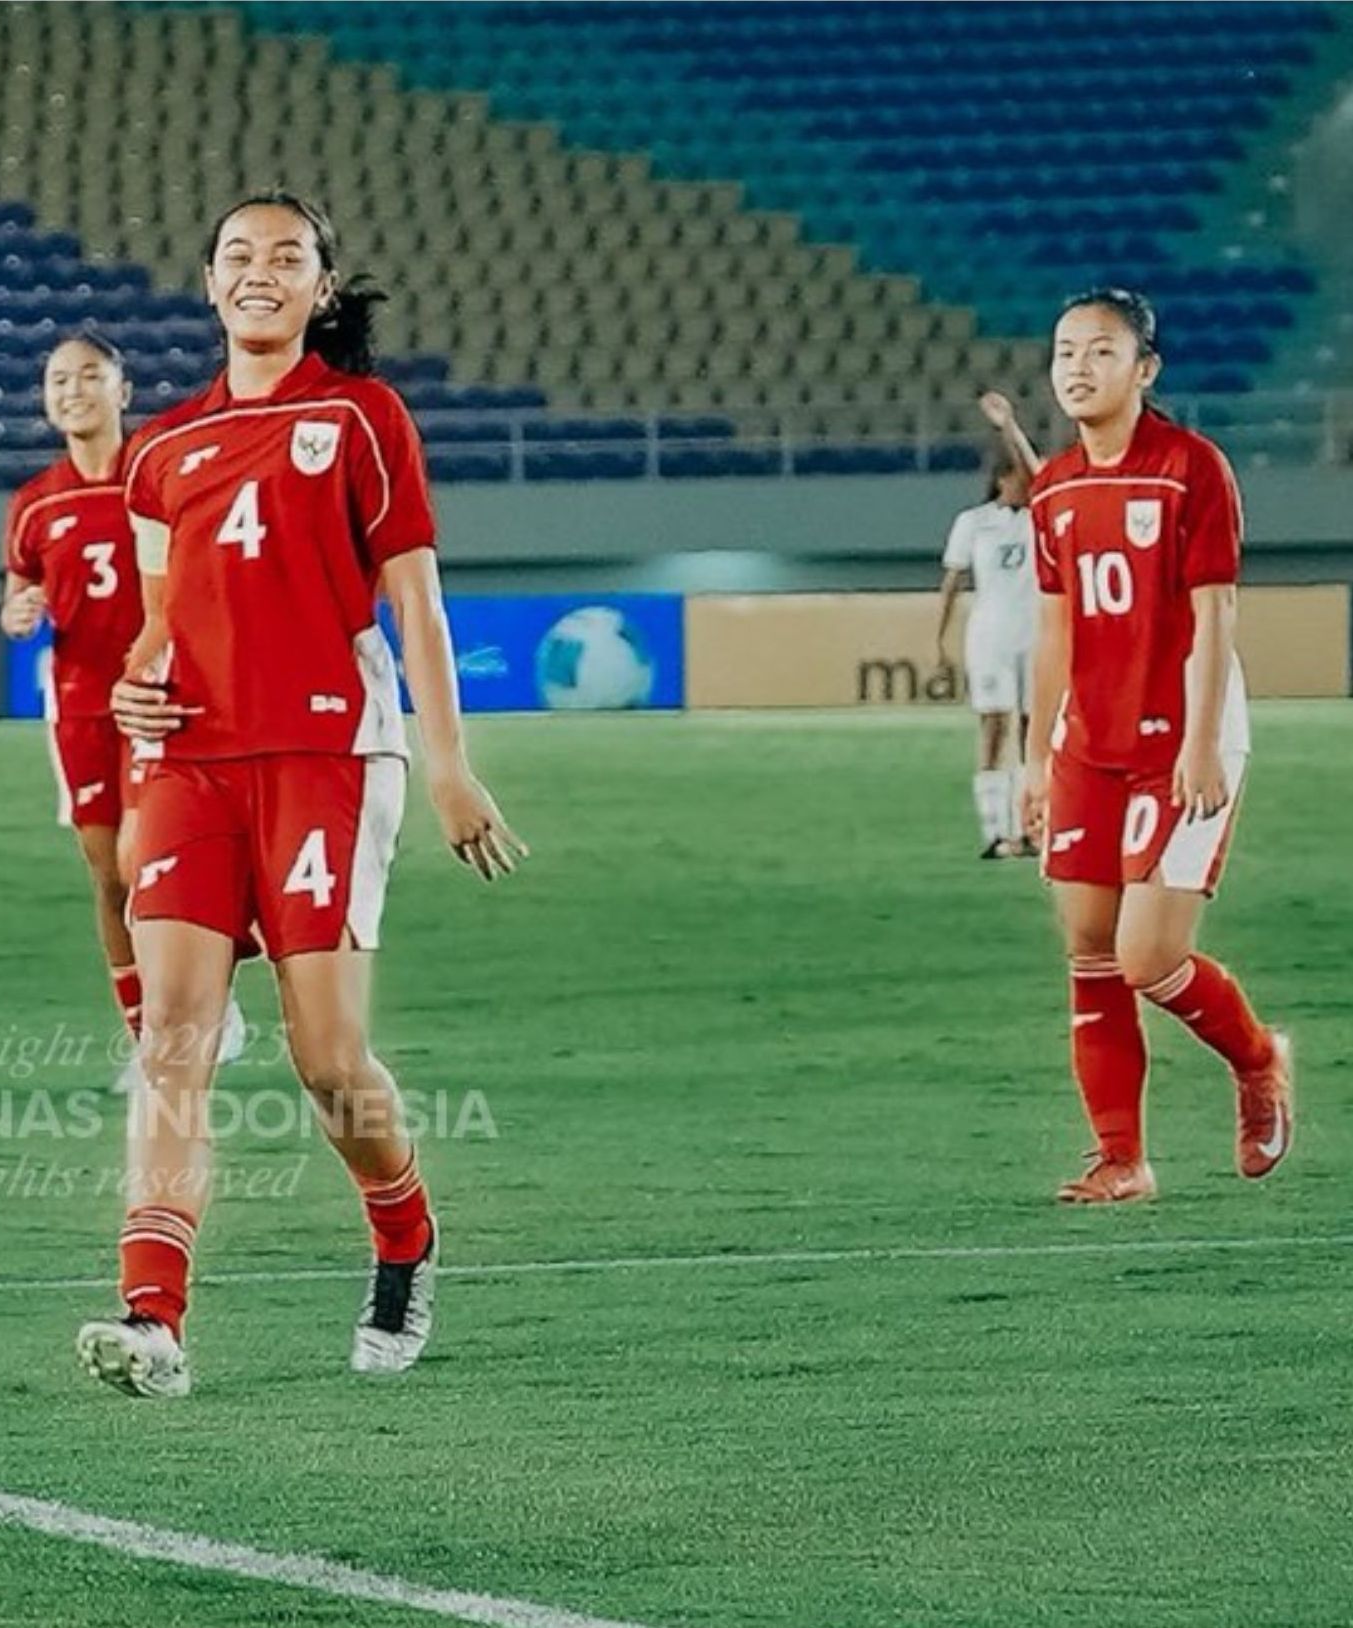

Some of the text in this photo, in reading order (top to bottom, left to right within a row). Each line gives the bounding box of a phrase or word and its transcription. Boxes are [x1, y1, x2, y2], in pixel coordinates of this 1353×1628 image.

[216, 480, 268, 560] 4
[81, 541, 119, 599] 3
[1077, 550, 1134, 618] 10
[859, 658, 970, 702] ma
[282, 828, 338, 909] 4
